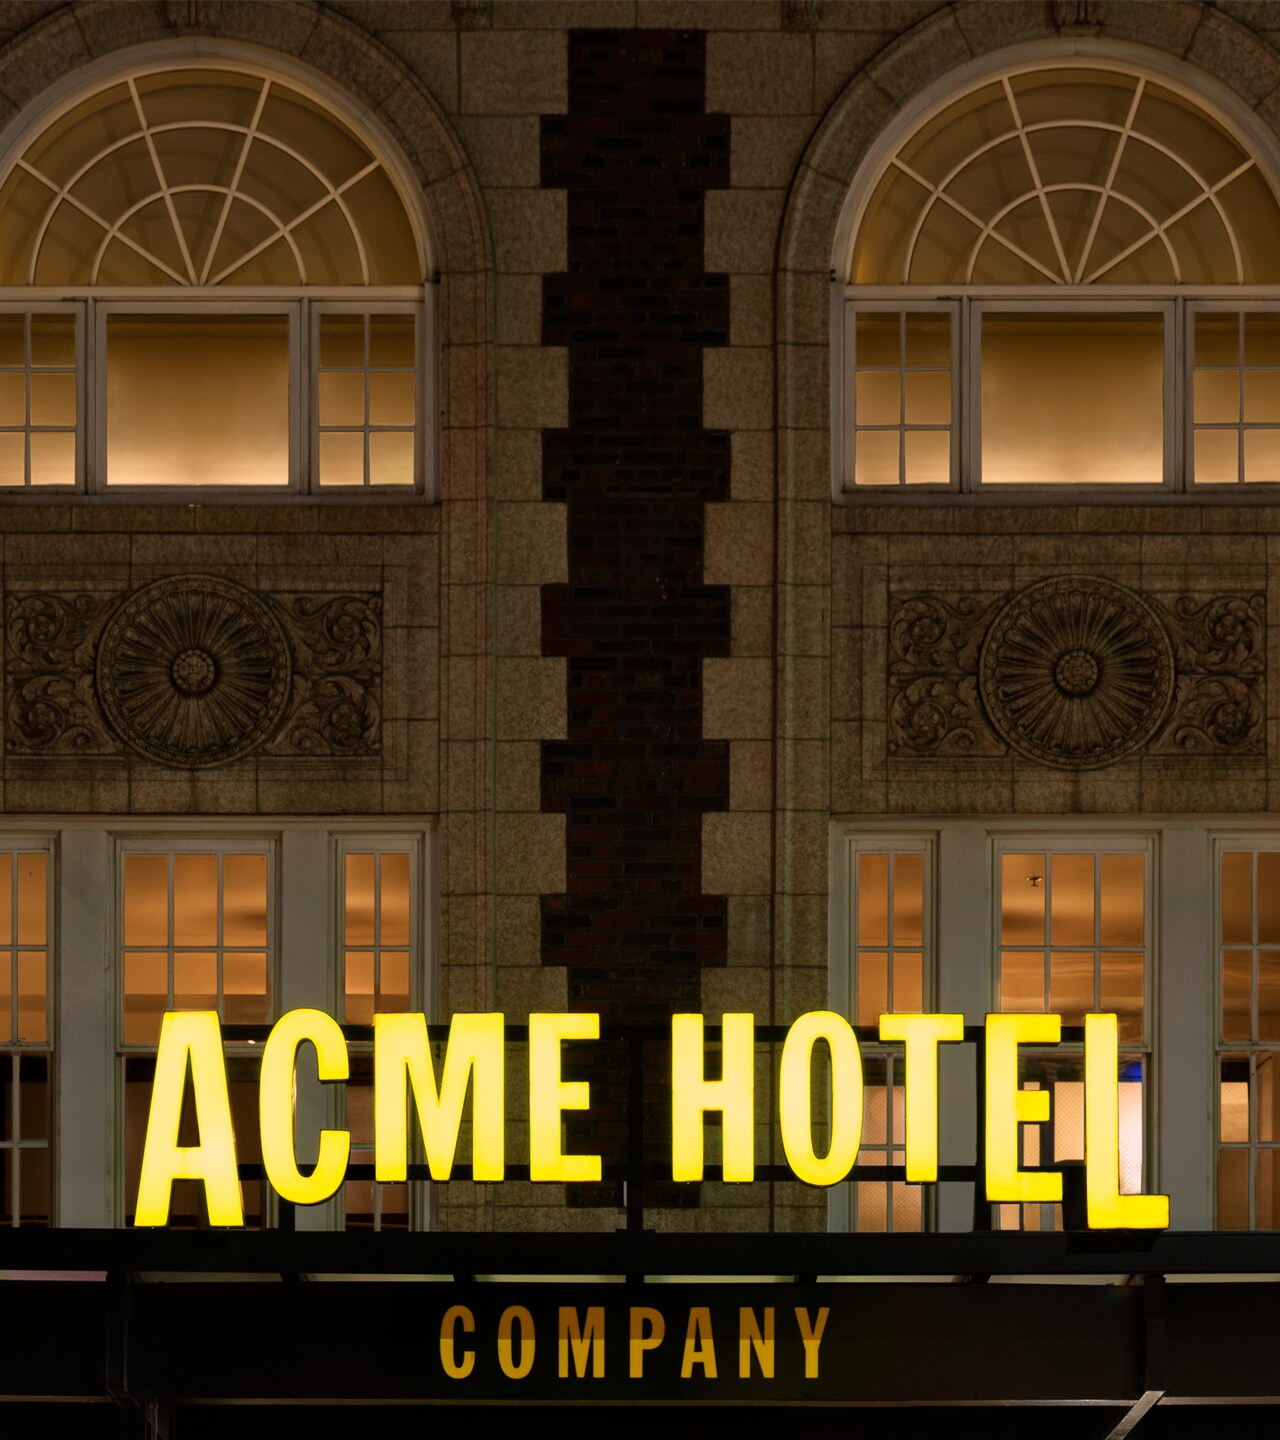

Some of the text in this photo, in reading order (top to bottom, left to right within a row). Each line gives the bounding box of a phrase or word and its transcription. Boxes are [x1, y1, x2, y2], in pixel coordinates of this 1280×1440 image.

[132, 1007, 1170, 1231] ACME HOTEL
[438, 1303, 831, 1380] COMPANY
